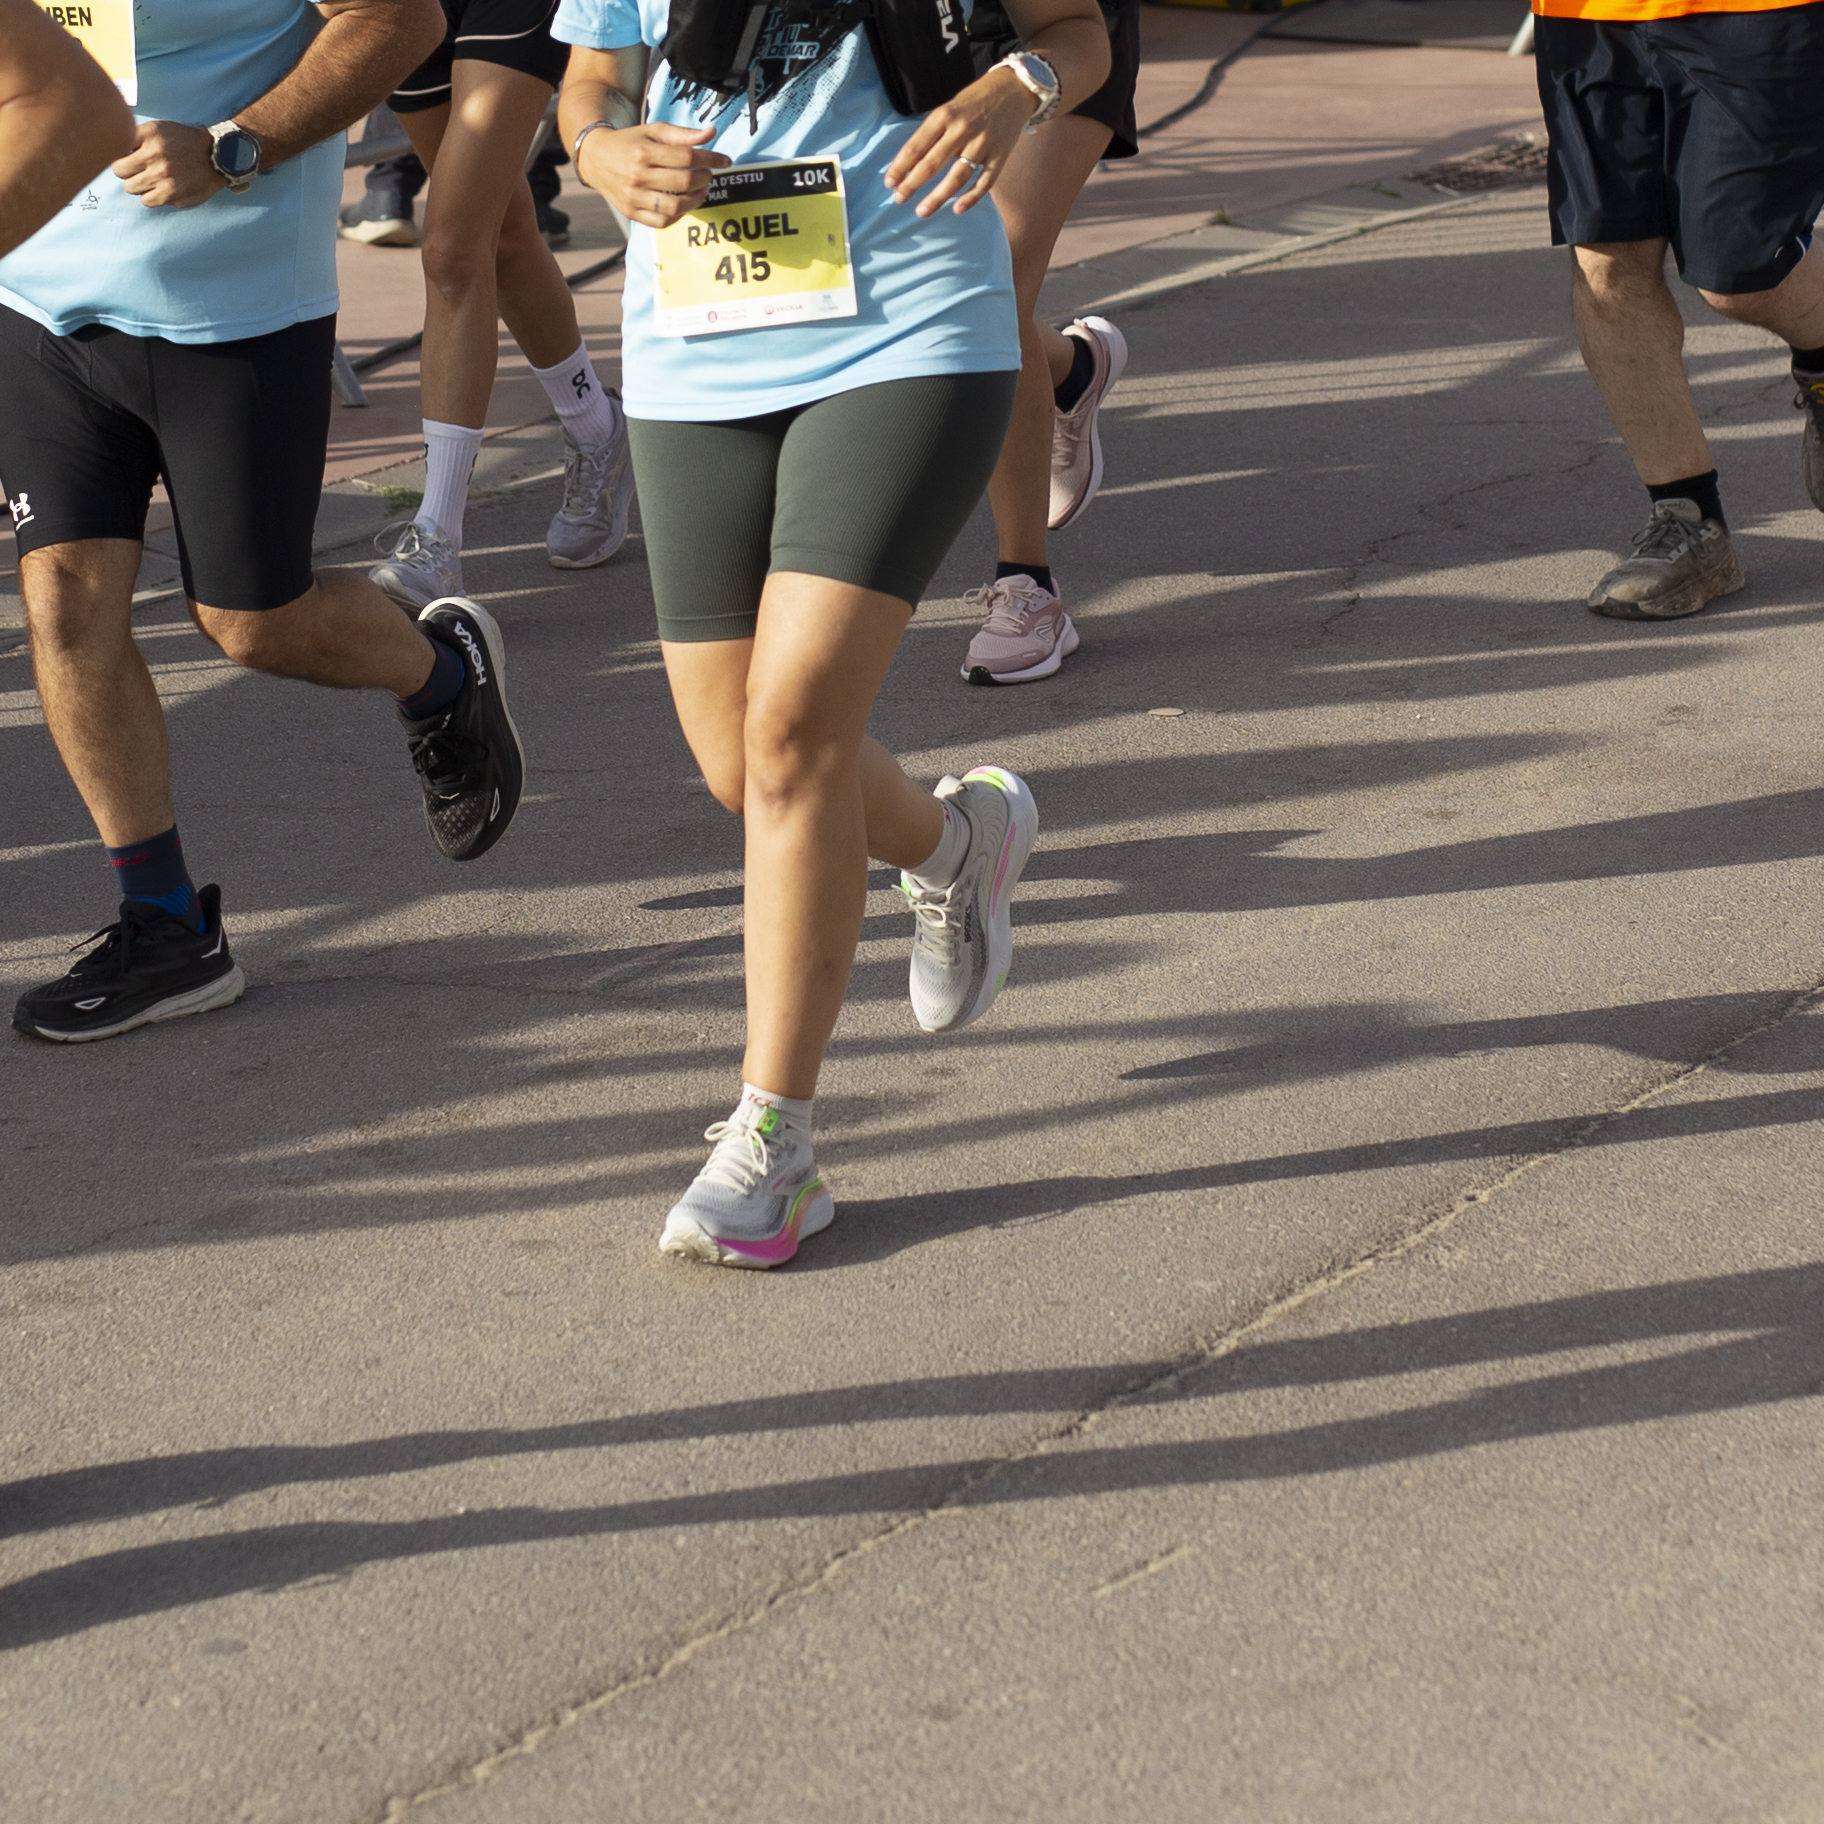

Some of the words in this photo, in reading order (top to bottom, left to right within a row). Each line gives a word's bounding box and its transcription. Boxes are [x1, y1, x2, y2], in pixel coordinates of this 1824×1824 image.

[720, 172, 765, 188] D'ESTIU
[792, 168, 831, 187] 10K
[708, 190, 729, 202] MAR
[687, 212, 800, 248] RAQUEL
[714, 250, 772, 286] 415
[454, 620, 487, 687] HOKA
